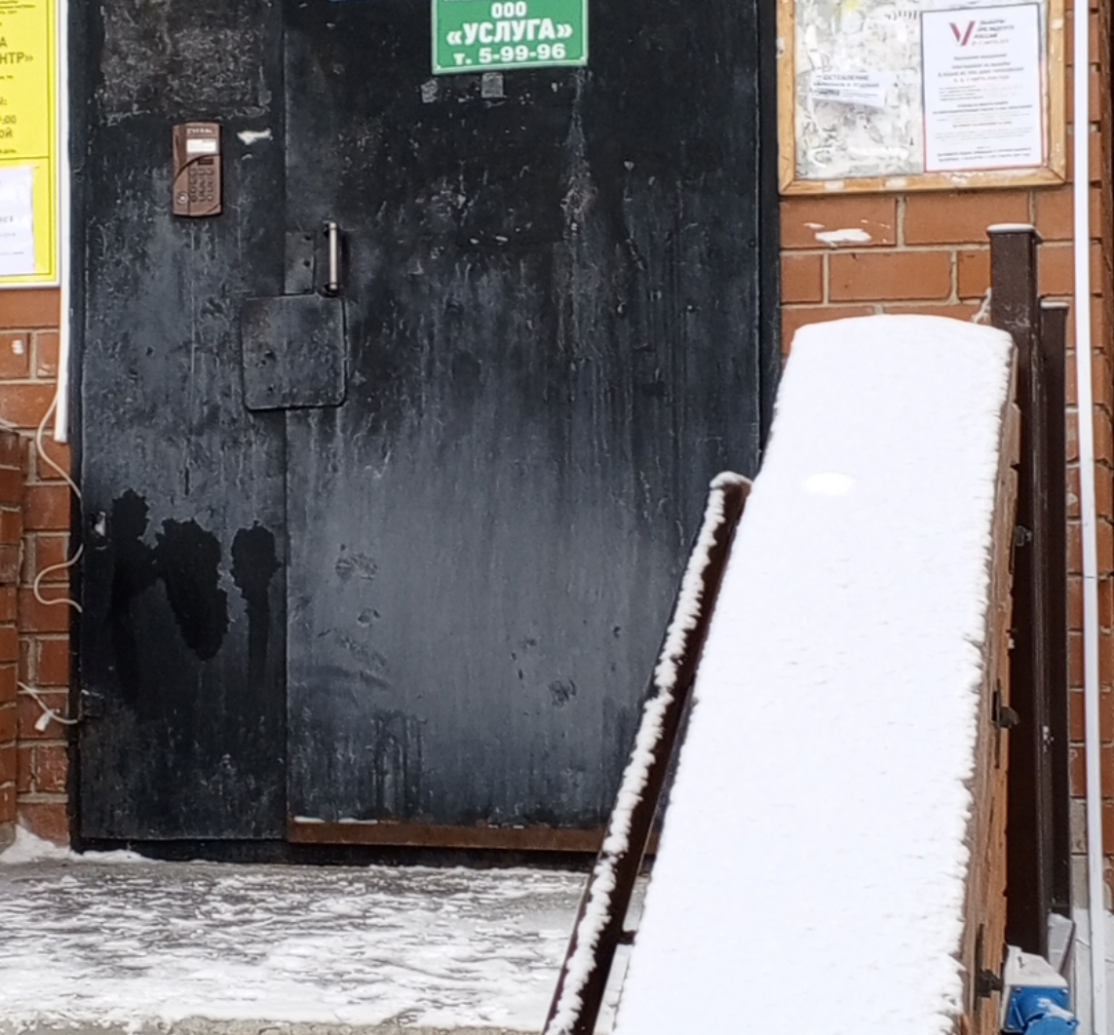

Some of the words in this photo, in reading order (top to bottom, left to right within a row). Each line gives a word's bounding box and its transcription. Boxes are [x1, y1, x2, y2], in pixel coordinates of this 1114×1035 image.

[491, 1, 527, 18] ООО
[446, 18, 573, 45] «УСЛУГА»
[479, 43, 566, 63] 5-99-96
